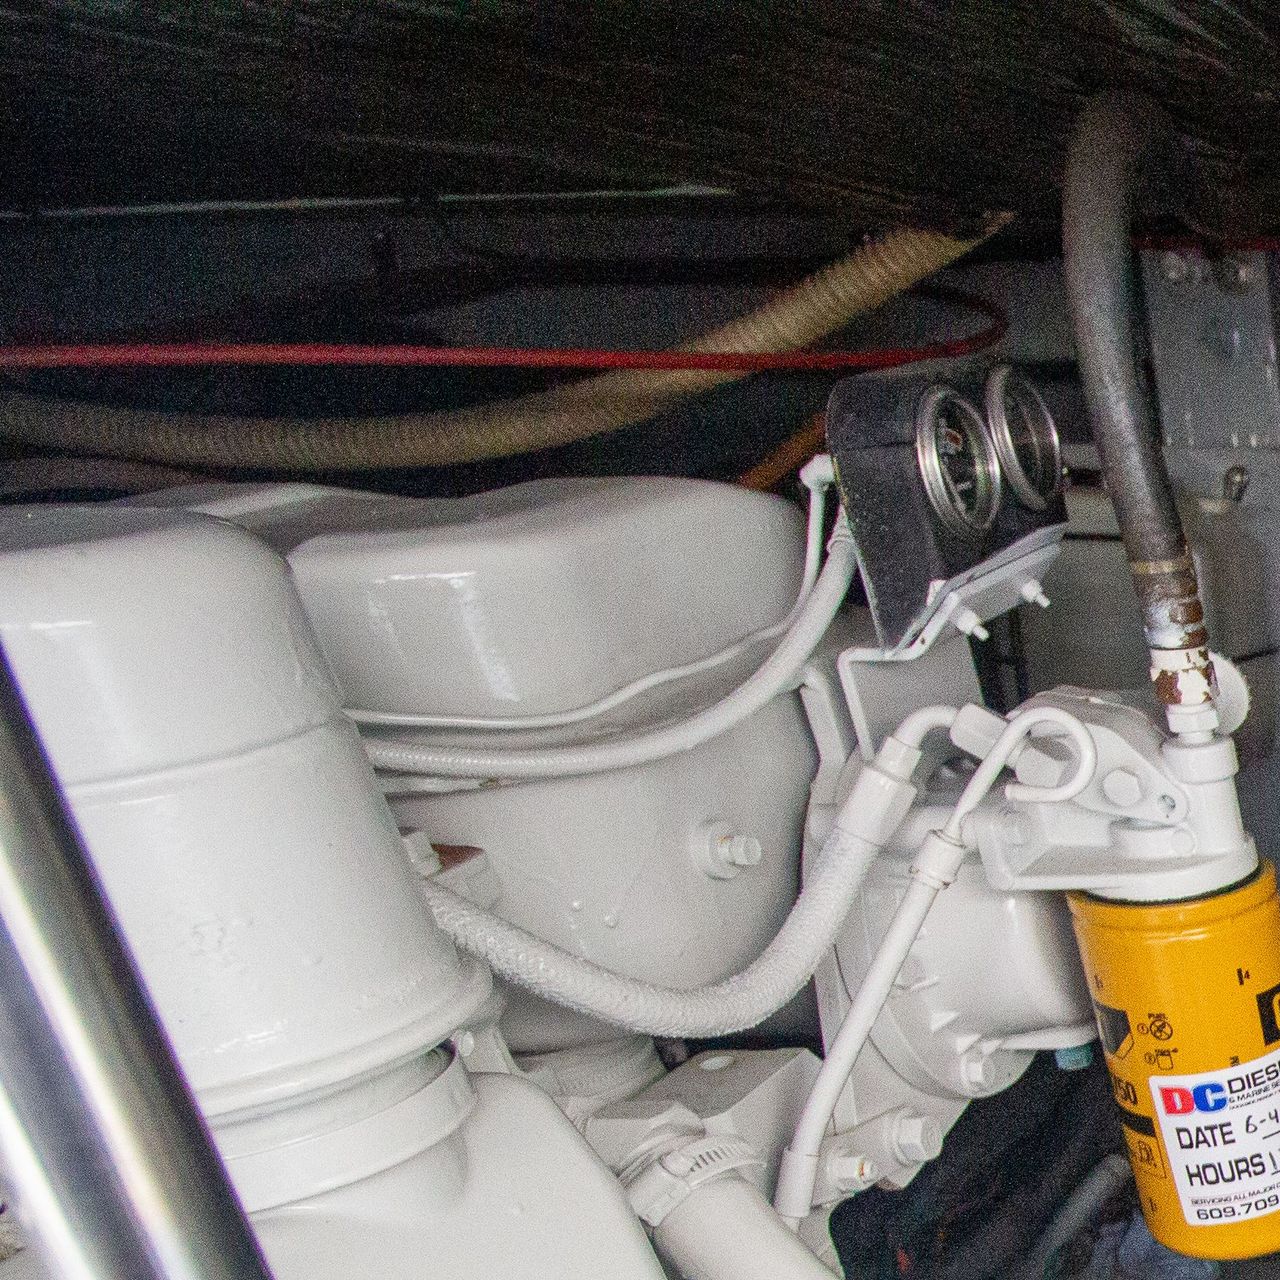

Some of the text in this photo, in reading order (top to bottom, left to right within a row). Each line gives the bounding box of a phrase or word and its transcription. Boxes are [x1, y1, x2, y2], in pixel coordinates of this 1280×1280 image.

[1159, 1080, 1229, 1115] DC
[1237, 1086, 1271, 1102] MARINE
[1176, 1122, 1236, 1150] DATE
[1185, 1153, 1266, 1187] HOURS
